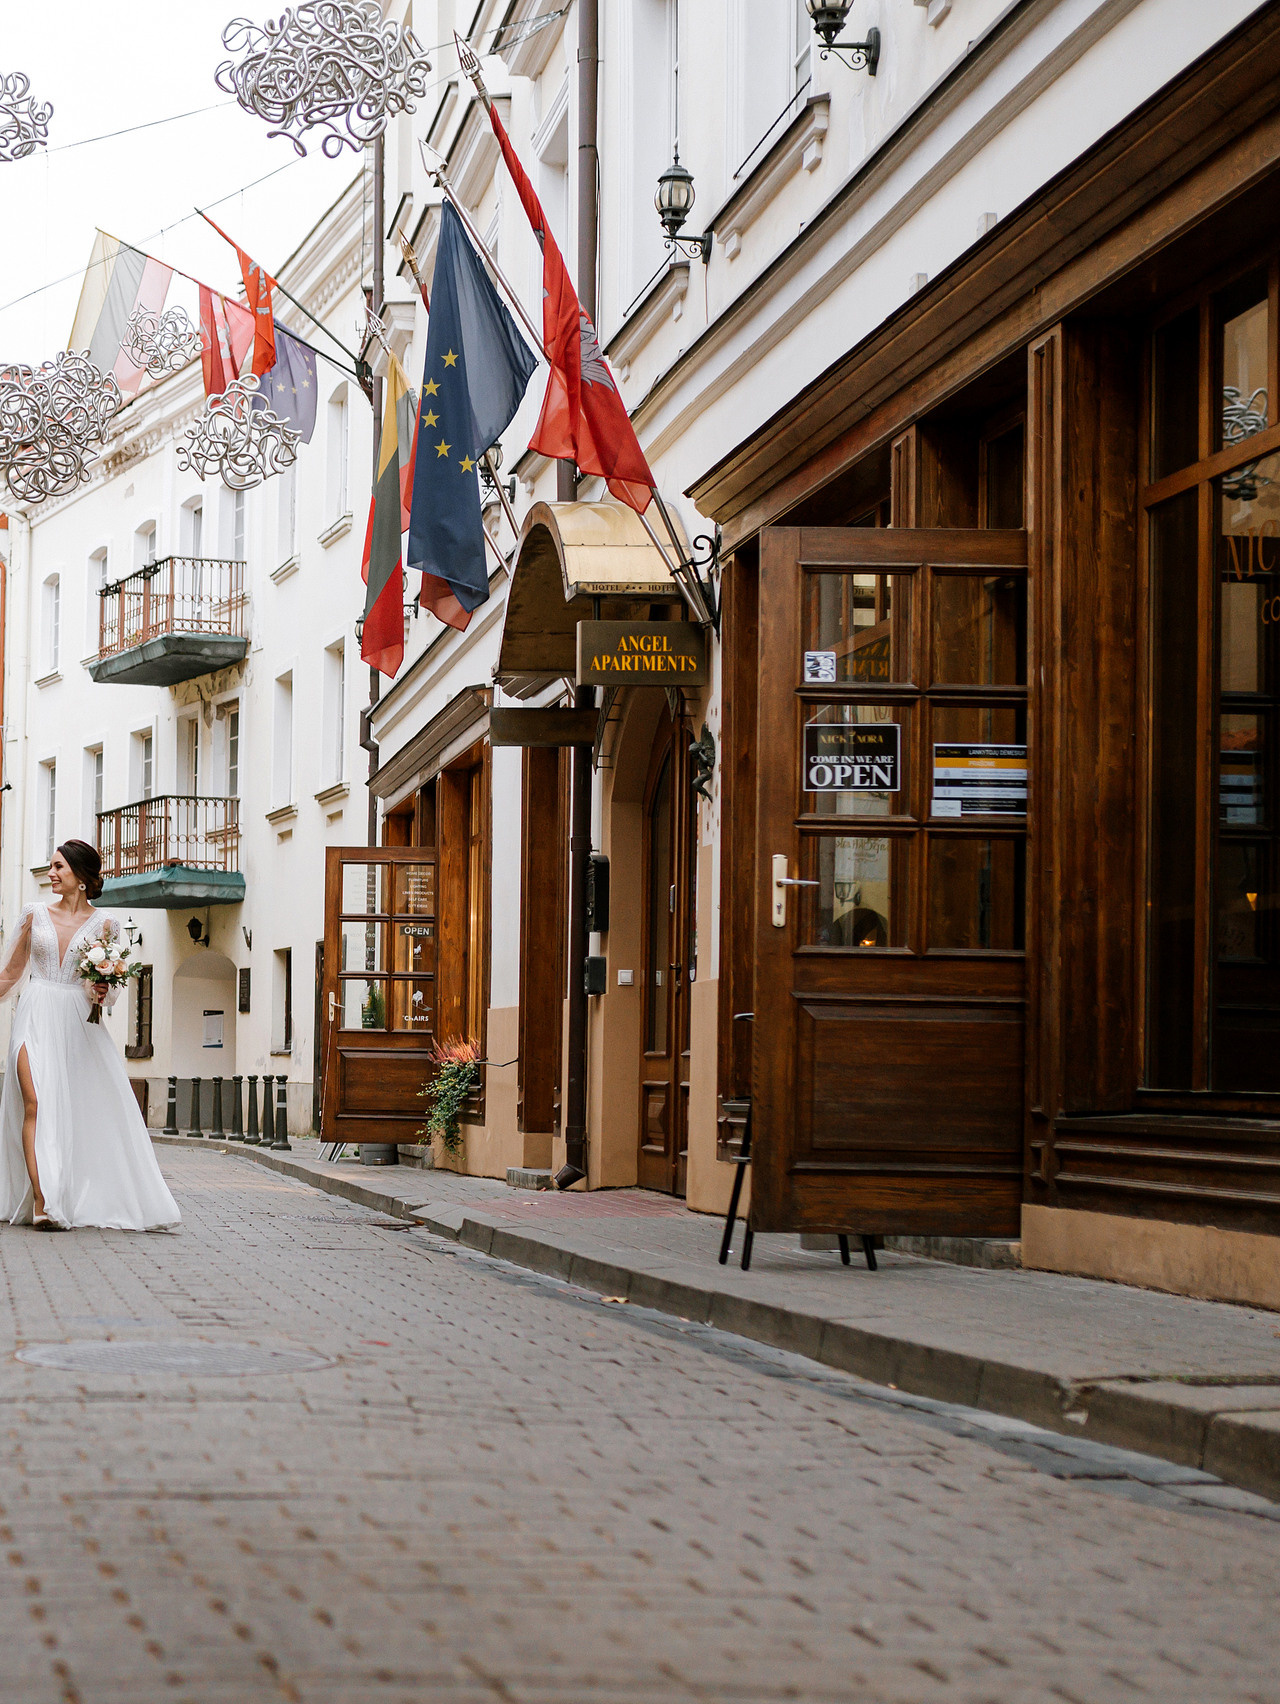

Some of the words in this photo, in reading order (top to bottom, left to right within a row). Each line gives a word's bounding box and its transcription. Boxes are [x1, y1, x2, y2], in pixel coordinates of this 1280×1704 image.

[617, 635, 673, 652] ANGEL
[590, 655, 698, 671] APARTMENTS
[821, 735, 847, 744] NICK
[857, 734, 884, 744] NORA
[809, 755, 840, 764] COME
[841, 755, 855, 764] IN!
[855, 755, 874, 764] WE
[875, 755, 895, 764] ARE
[809, 764, 894, 787] OPEN
[404, 926, 430, 936] OPEN
